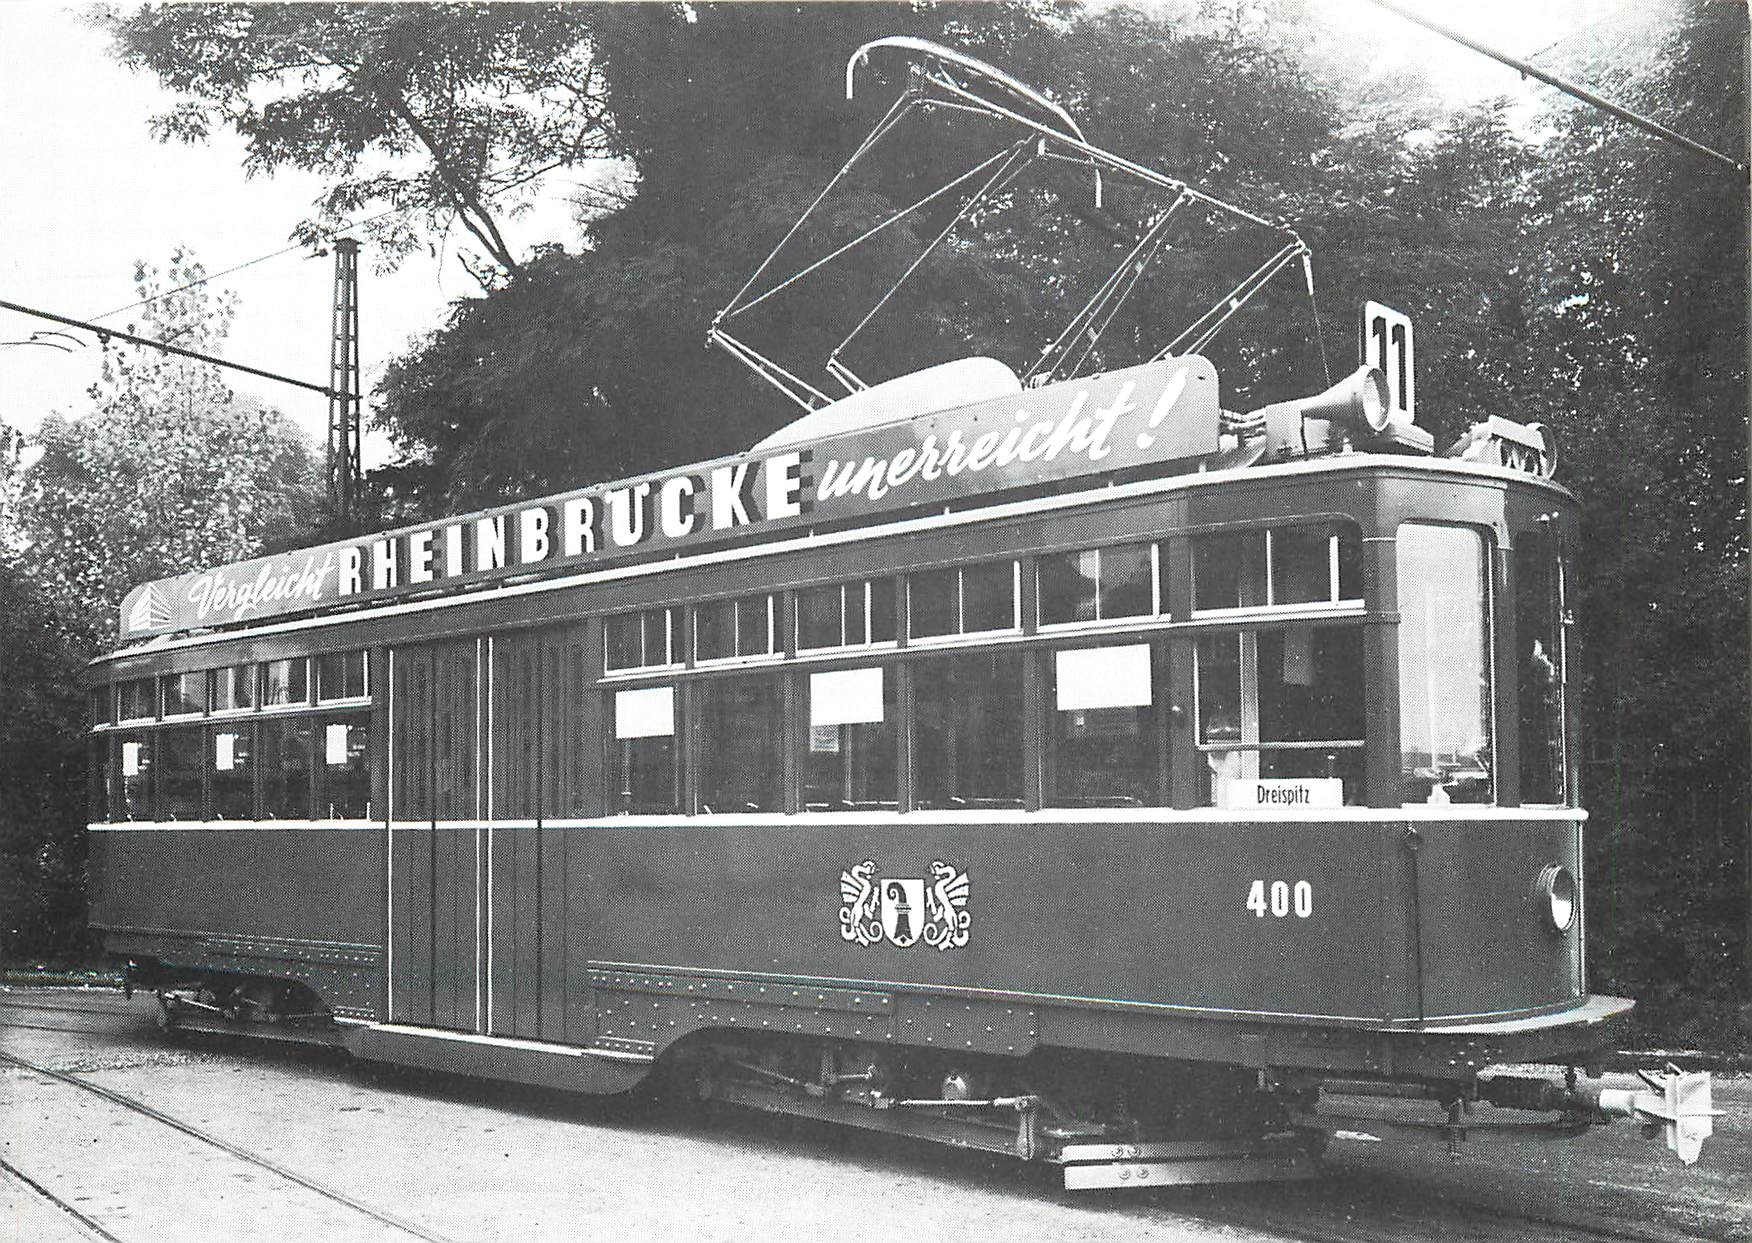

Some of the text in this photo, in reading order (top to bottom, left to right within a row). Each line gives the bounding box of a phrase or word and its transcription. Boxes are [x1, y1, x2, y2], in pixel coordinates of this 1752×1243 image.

[1372, 315, 1407, 411] 11
[188, 554, 335, 621] Vergleicht
[338, 452, 802, 596] RHEINBRÜCKE
[1257, 784, 1310, 806] Dreispitz
[1246, 880, 1313, 918] 400
